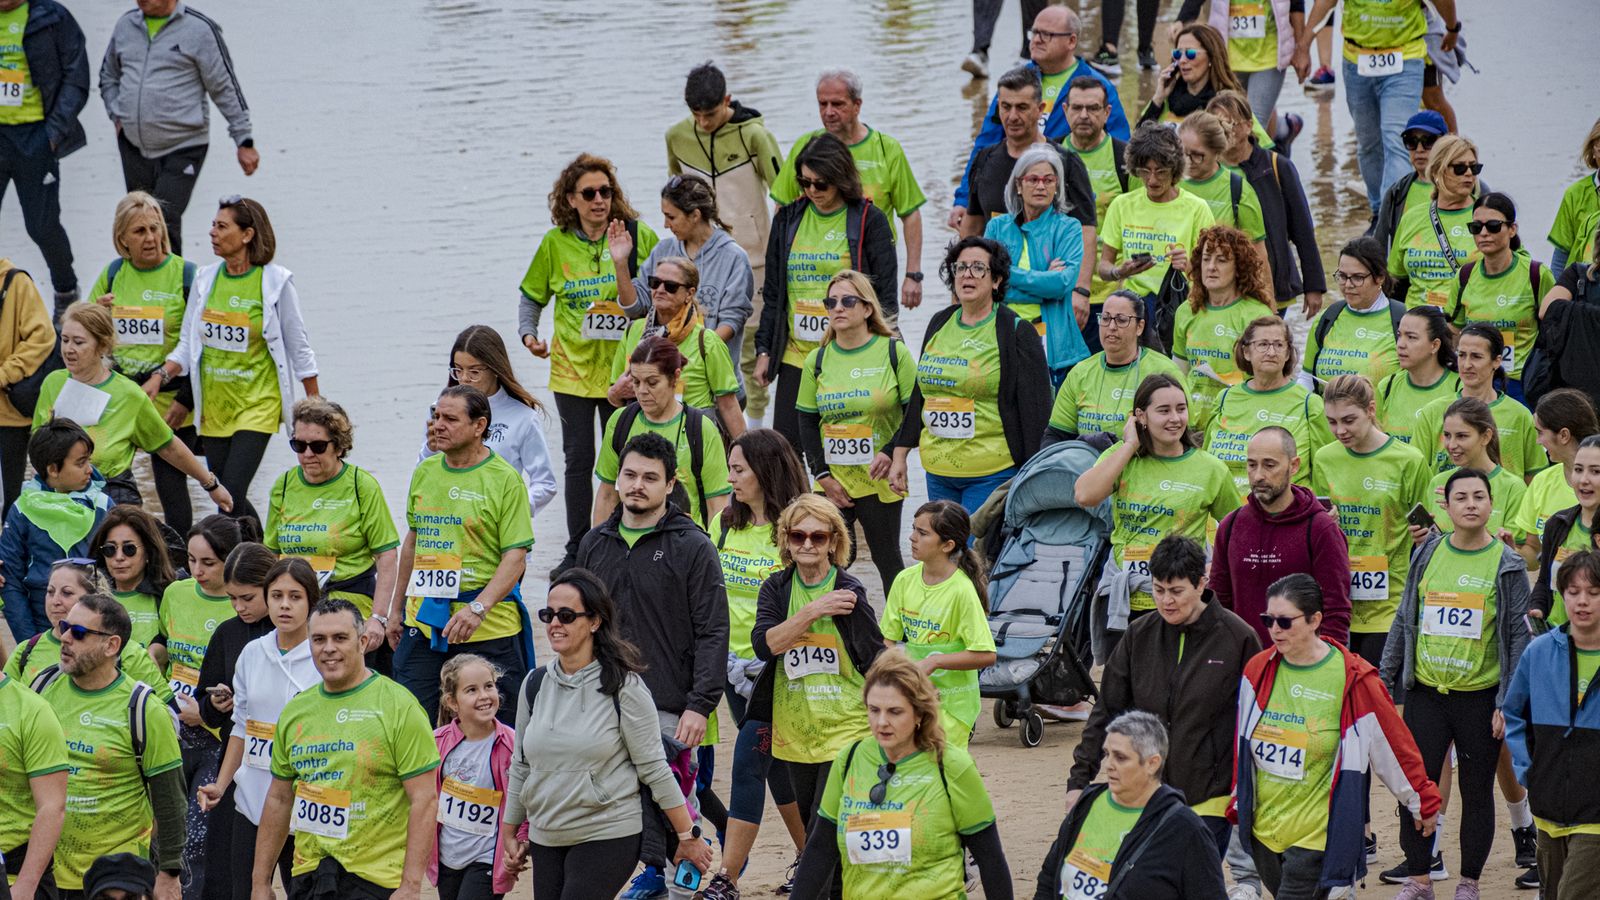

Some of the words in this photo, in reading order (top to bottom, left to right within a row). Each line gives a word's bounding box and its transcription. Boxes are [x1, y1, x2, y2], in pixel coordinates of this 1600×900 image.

[1232, 16, 1257, 30] 331
[1369, 53, 1395, 68] 330
[1136, 230, 1177, 243] marcha
[798, 251, 840, 260] marcha
[1407, 248, 1421, 257] En
[578, 272, 616, 286] march
[118, 318, 160, 335] 3864
[587, 314, 625, 331] 1232
[204, 322, 245, 343] 3133
[1327, 347, 1368, 358] marcha
[824, 388, 870, 401] marcha
[929, 411, 972, 429] 2935
[1077, 421, 1102, 432] ontra
[828, 438, 870, 455] 2936
[1128, 502, 1175, 517] marcha
[423, 513, 462, 525] marcha
[285, 523, 327, 532] marcha
[1343, 526, 1375, 538] áncer
[722, 560, 747, 573] ontra
[730, 554, 775, 567] marcha
[415, 570, 457, 588] 3186
[1350, 571, 1386, 589] 462
[1437, 606, 1473, 627] 162
[789, 645, 835, 667] 3149
[291, 744, 303, 757] En
[306, 739, 355, 754] marcha
[1254, 741, 1302, 767] 4214
[297, 799, 345, 827] 3085
[446, 796, 495, 825] 1192
[860, 829, 900, 851] 339
